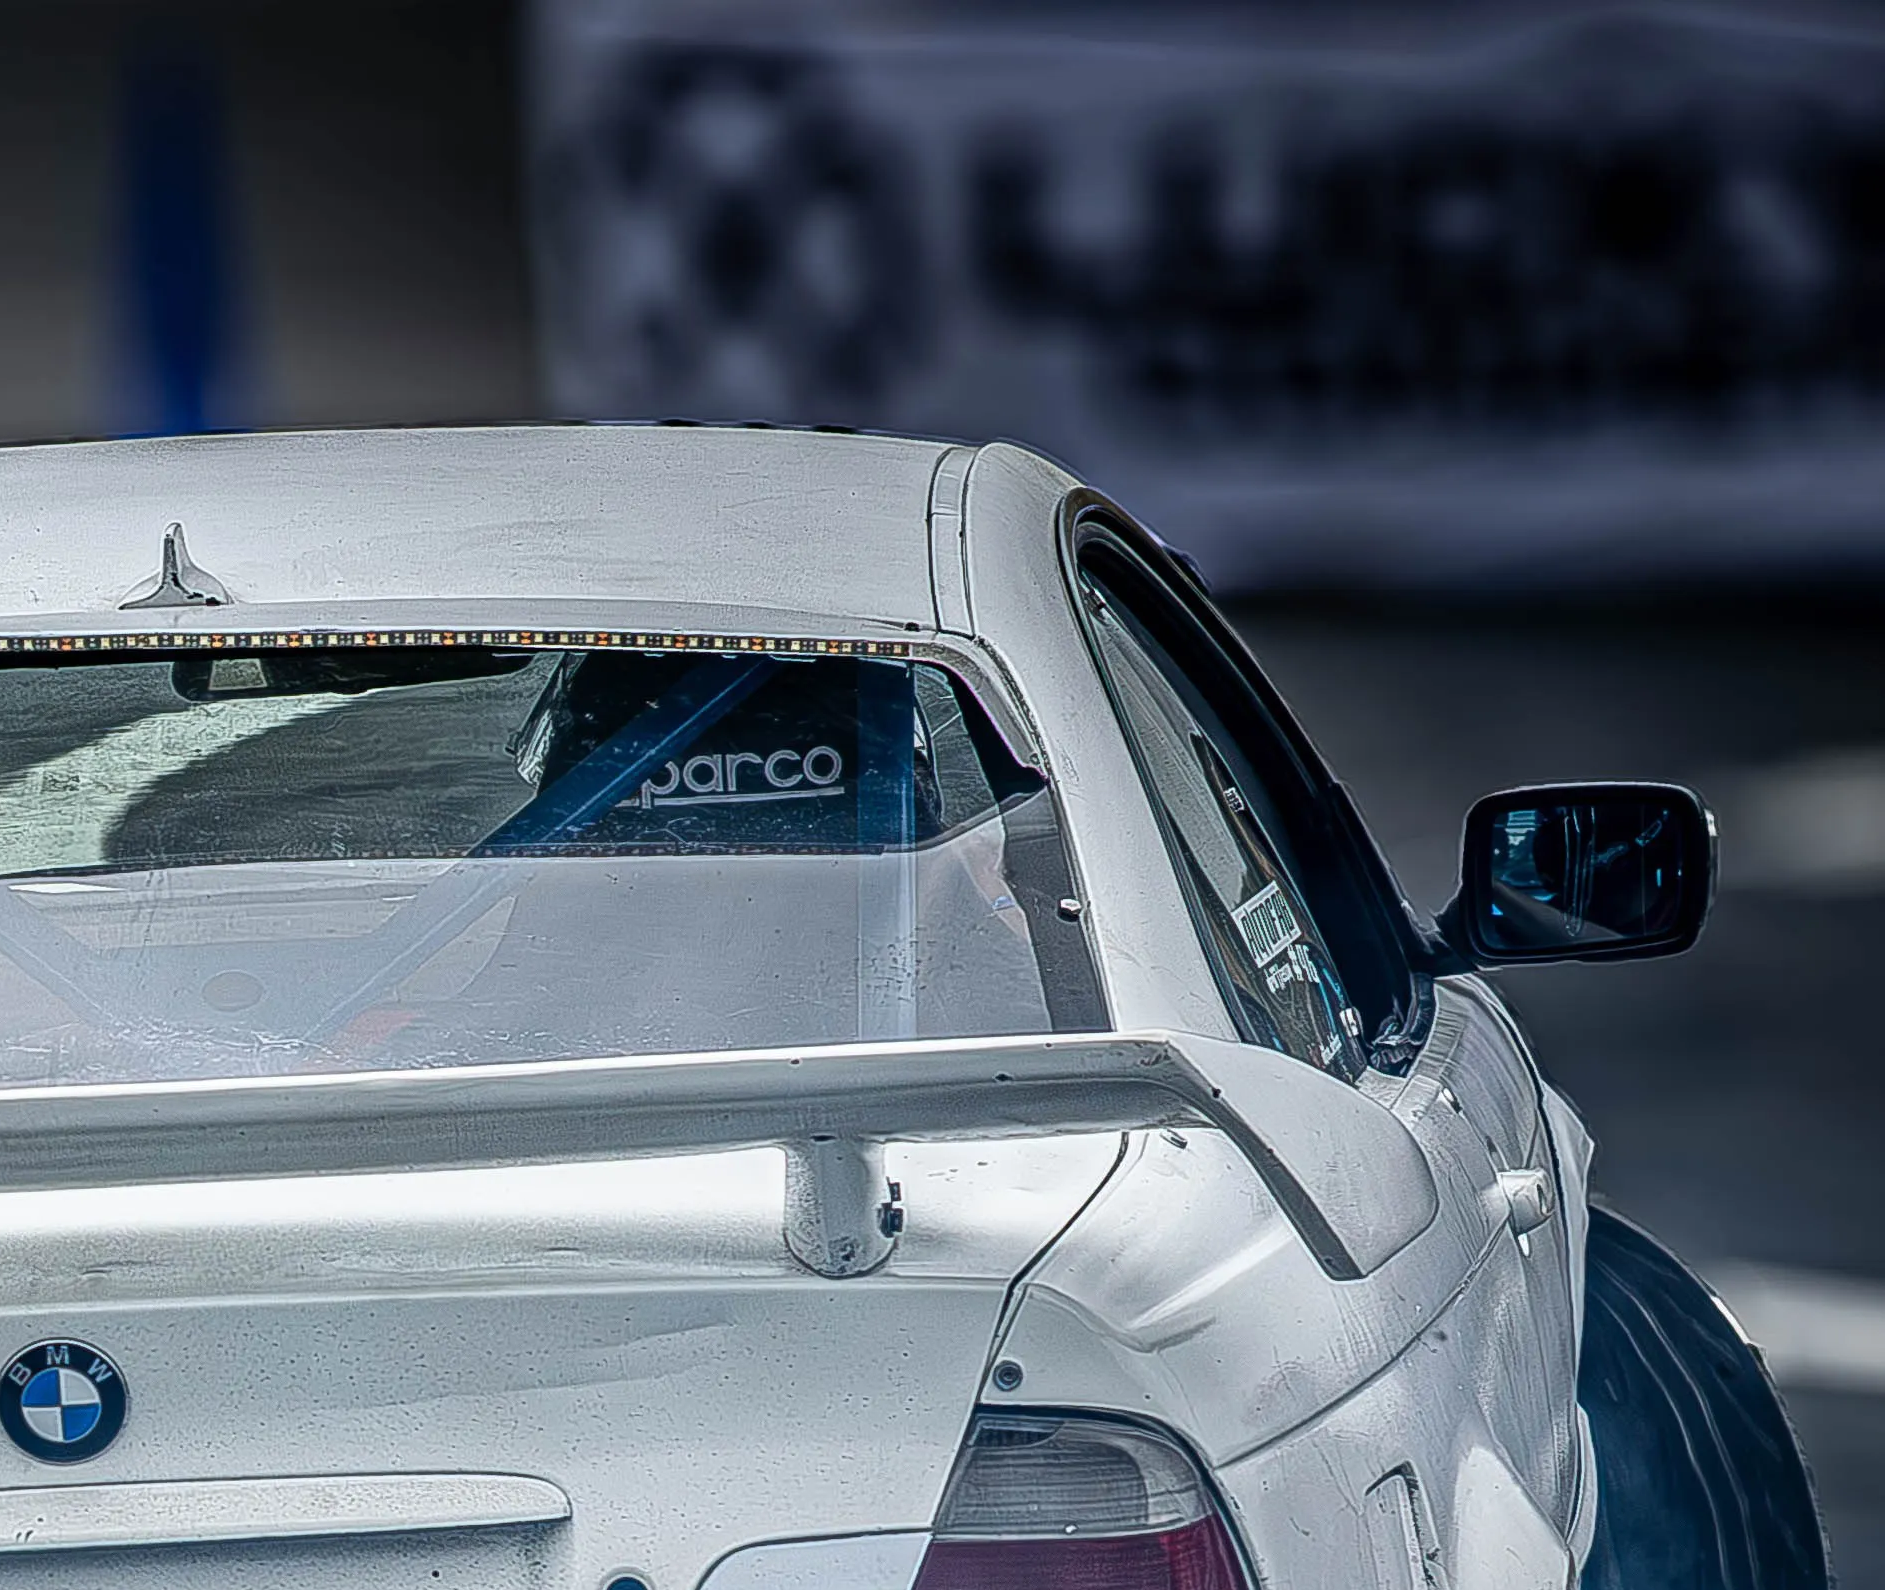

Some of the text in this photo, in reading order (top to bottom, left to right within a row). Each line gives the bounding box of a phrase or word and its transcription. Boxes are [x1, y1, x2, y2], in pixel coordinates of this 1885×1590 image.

[641, 744, 843, 810] parco
[1240, 889, 1295, 961] AUTOFAB
[7, 1345, 113, 1387] BMW
